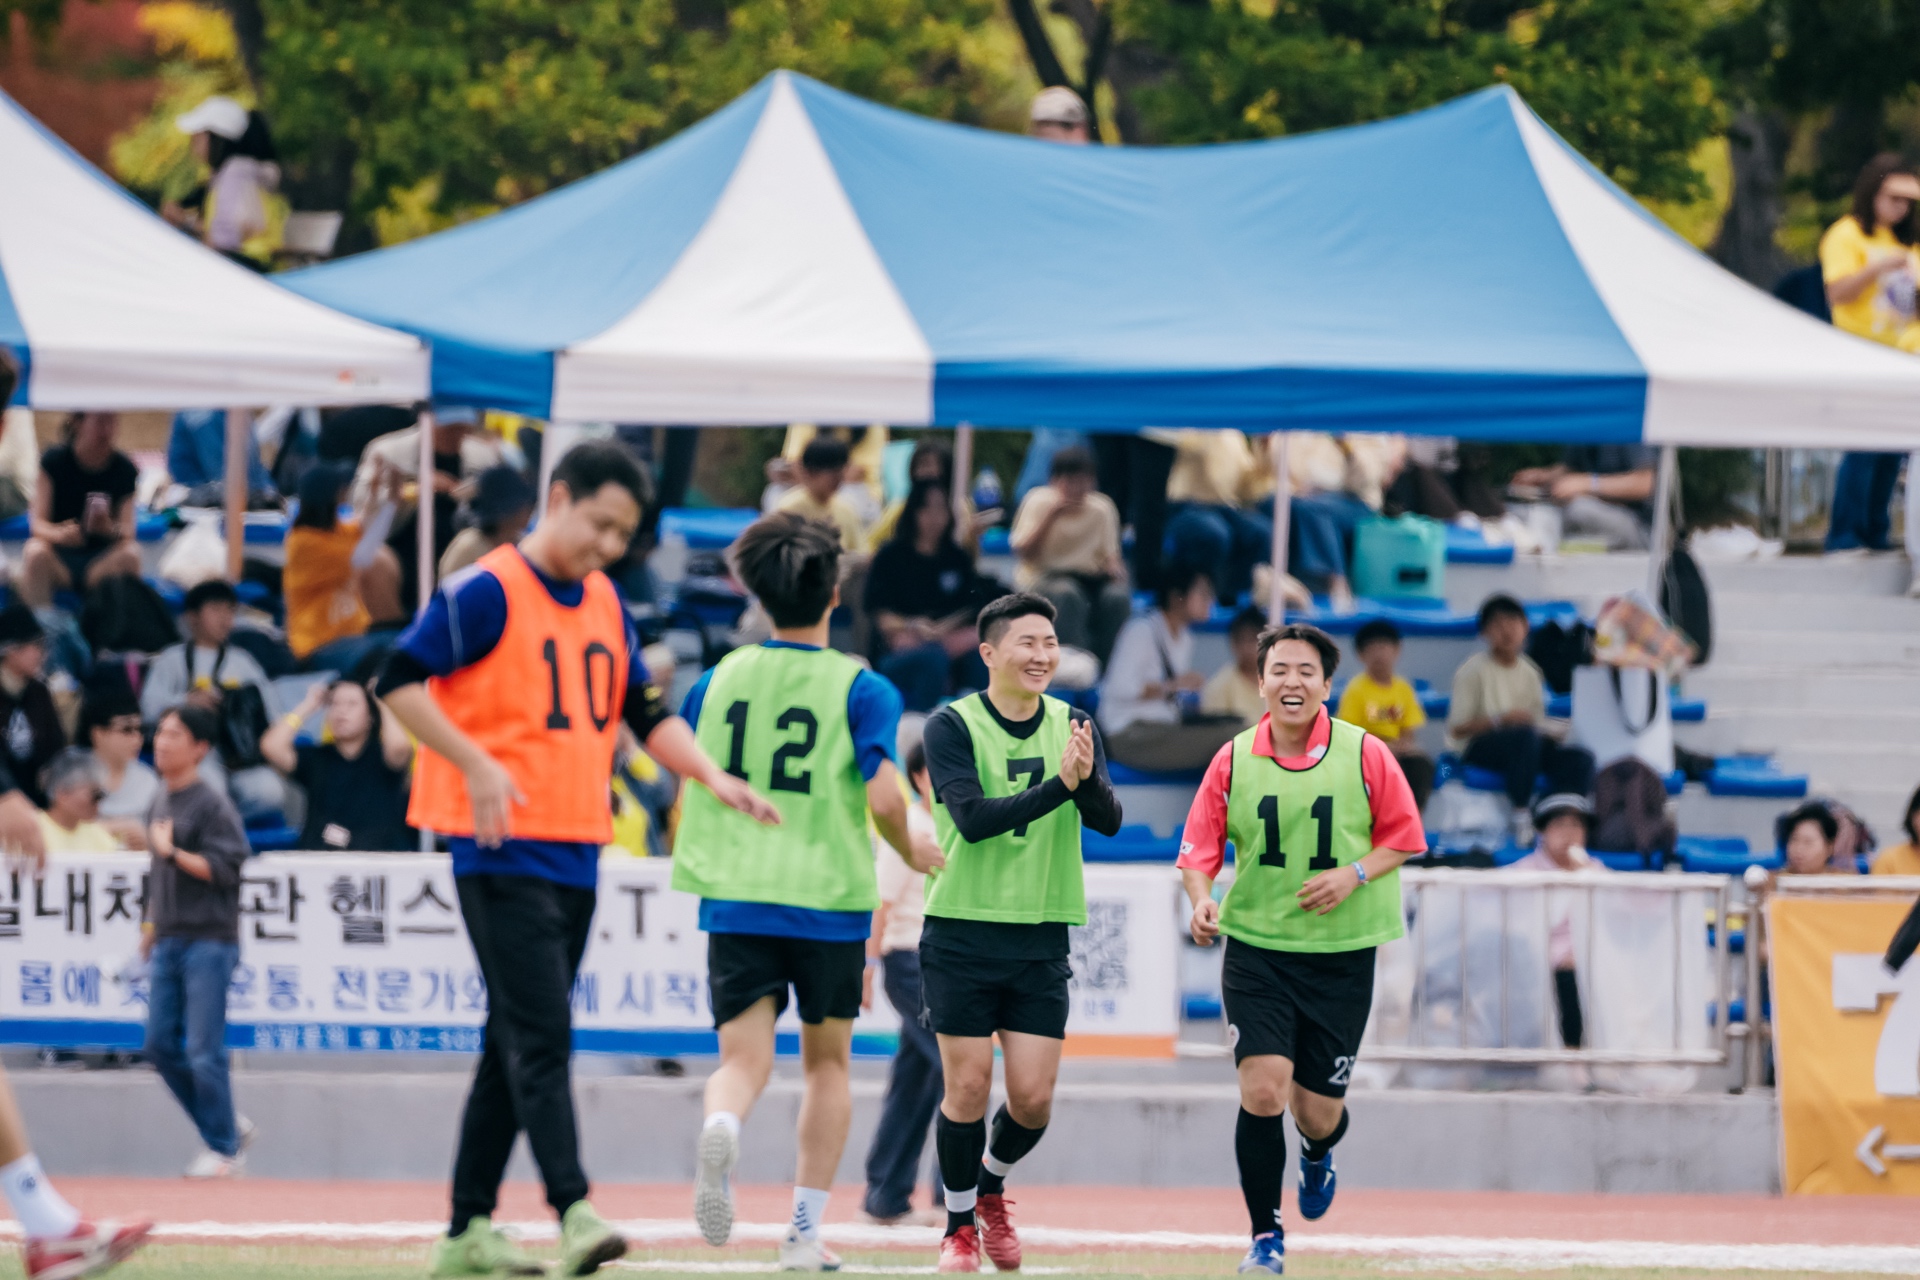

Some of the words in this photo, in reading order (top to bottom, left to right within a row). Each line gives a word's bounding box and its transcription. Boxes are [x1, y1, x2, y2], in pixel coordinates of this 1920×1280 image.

[543, 638, 614, 733] 10
[725, 700, 818, 796] 12
[1006, 756, 1045, 837] 7
[1257, 795, 1338, 871] 11
[329, 875, 456, 944] 헬스
